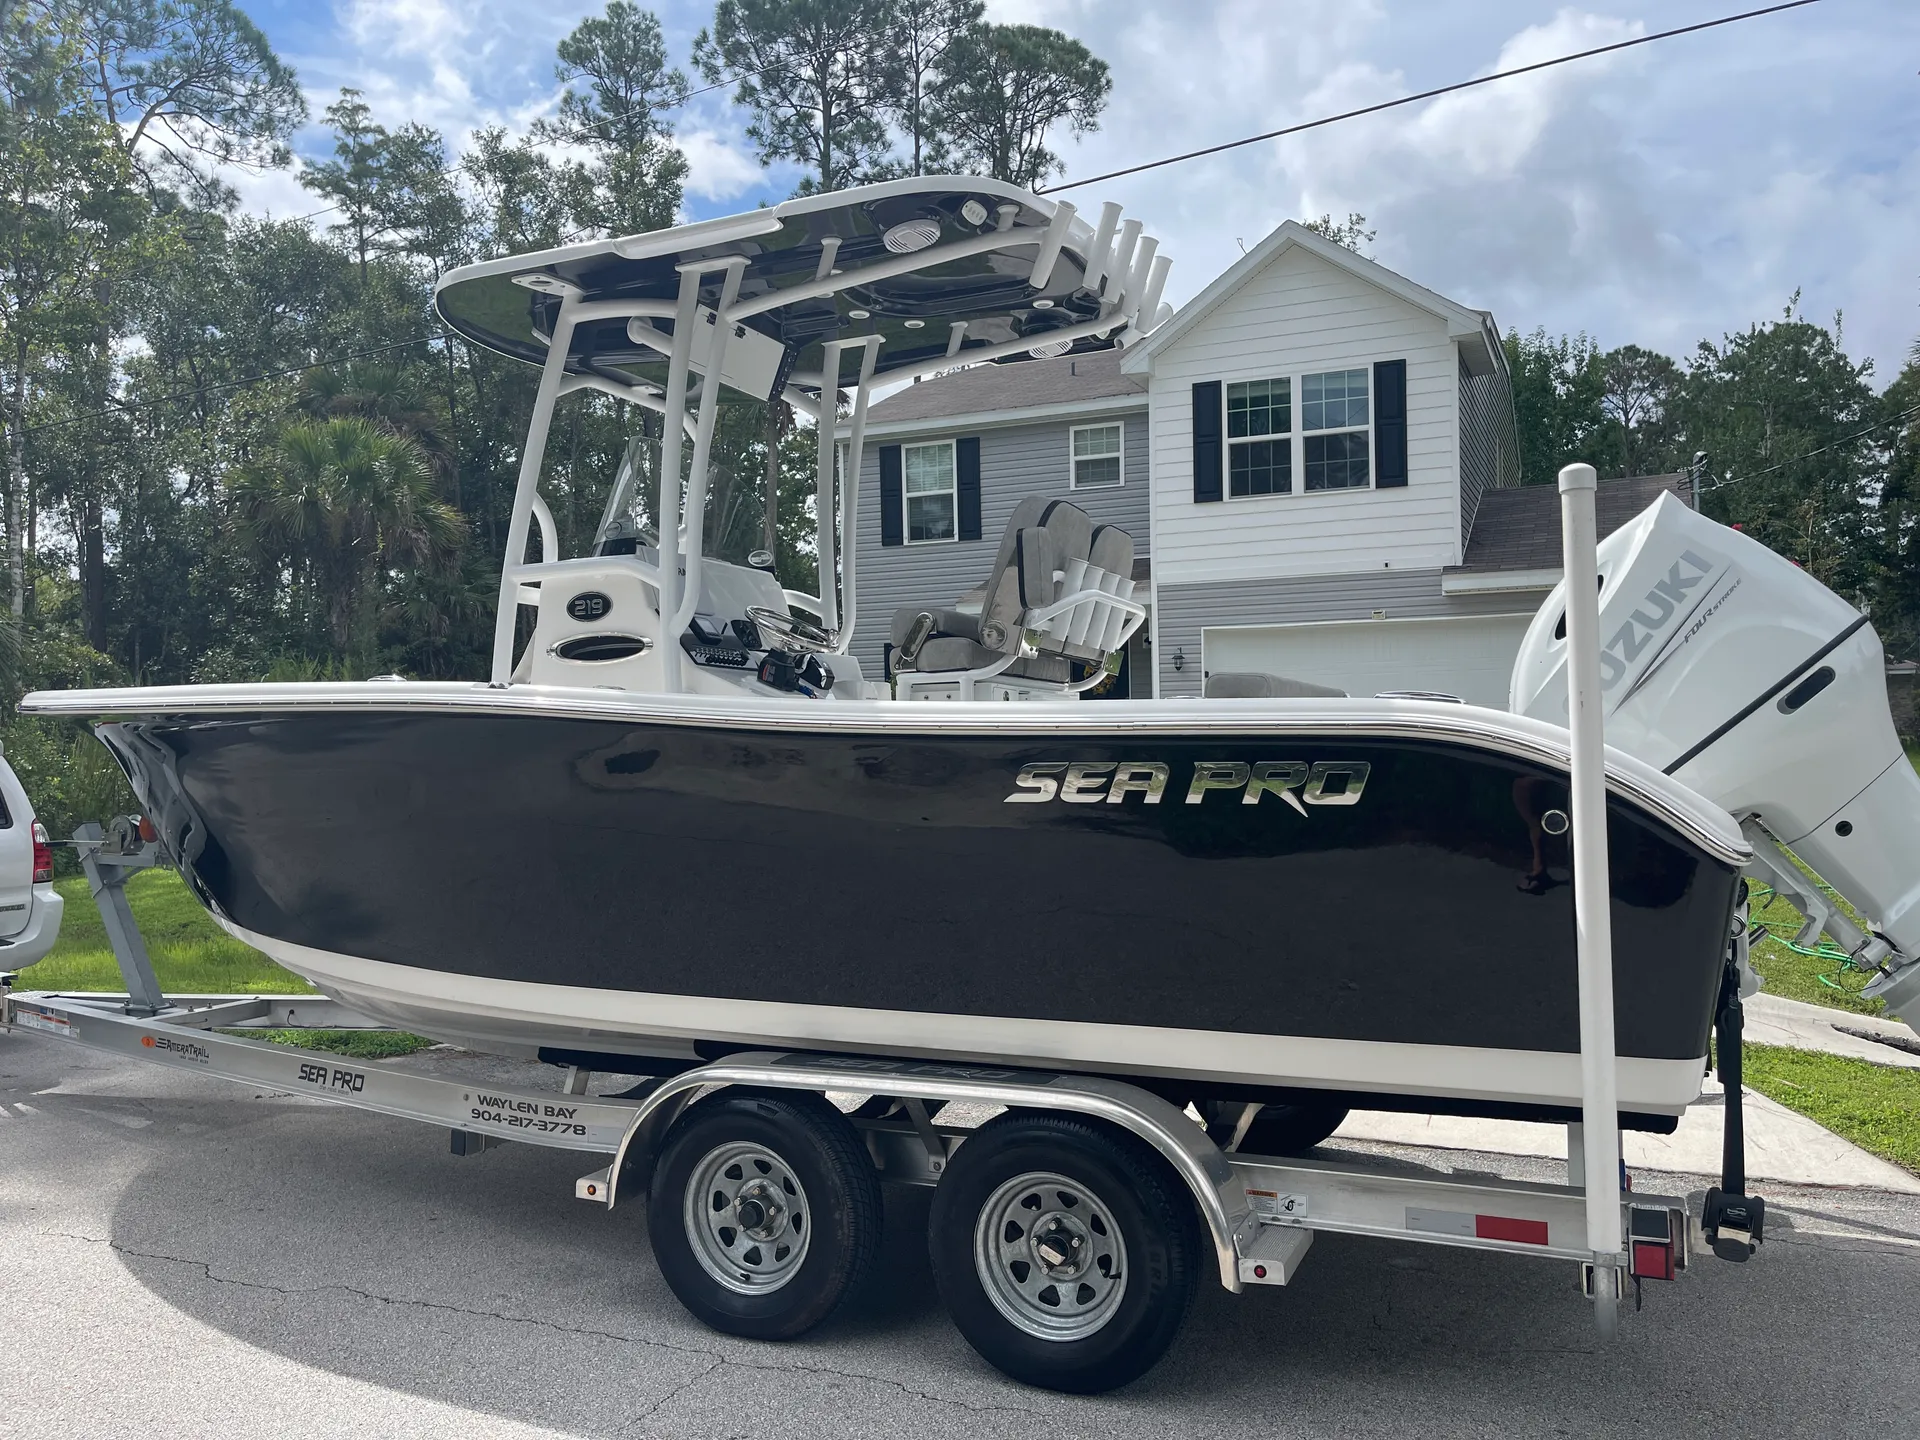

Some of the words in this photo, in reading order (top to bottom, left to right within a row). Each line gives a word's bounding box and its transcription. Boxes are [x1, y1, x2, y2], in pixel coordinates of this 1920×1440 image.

[574, 598, 603, 615] 219
[1563, 550, 1714, 715] UZUKI
[1003, 761, 1170, 804] SEA
[1185, 761, 1371, 818] PRO
[298, 1063, 327, 1085] SEA
[332, 1069, 365, 1096] PRO
[477, 1094, 539, 1115] WAYLEN
[544, 1105, 578, 1119] BAY
[471, 1108, 587, 1136] 904-217-3778
